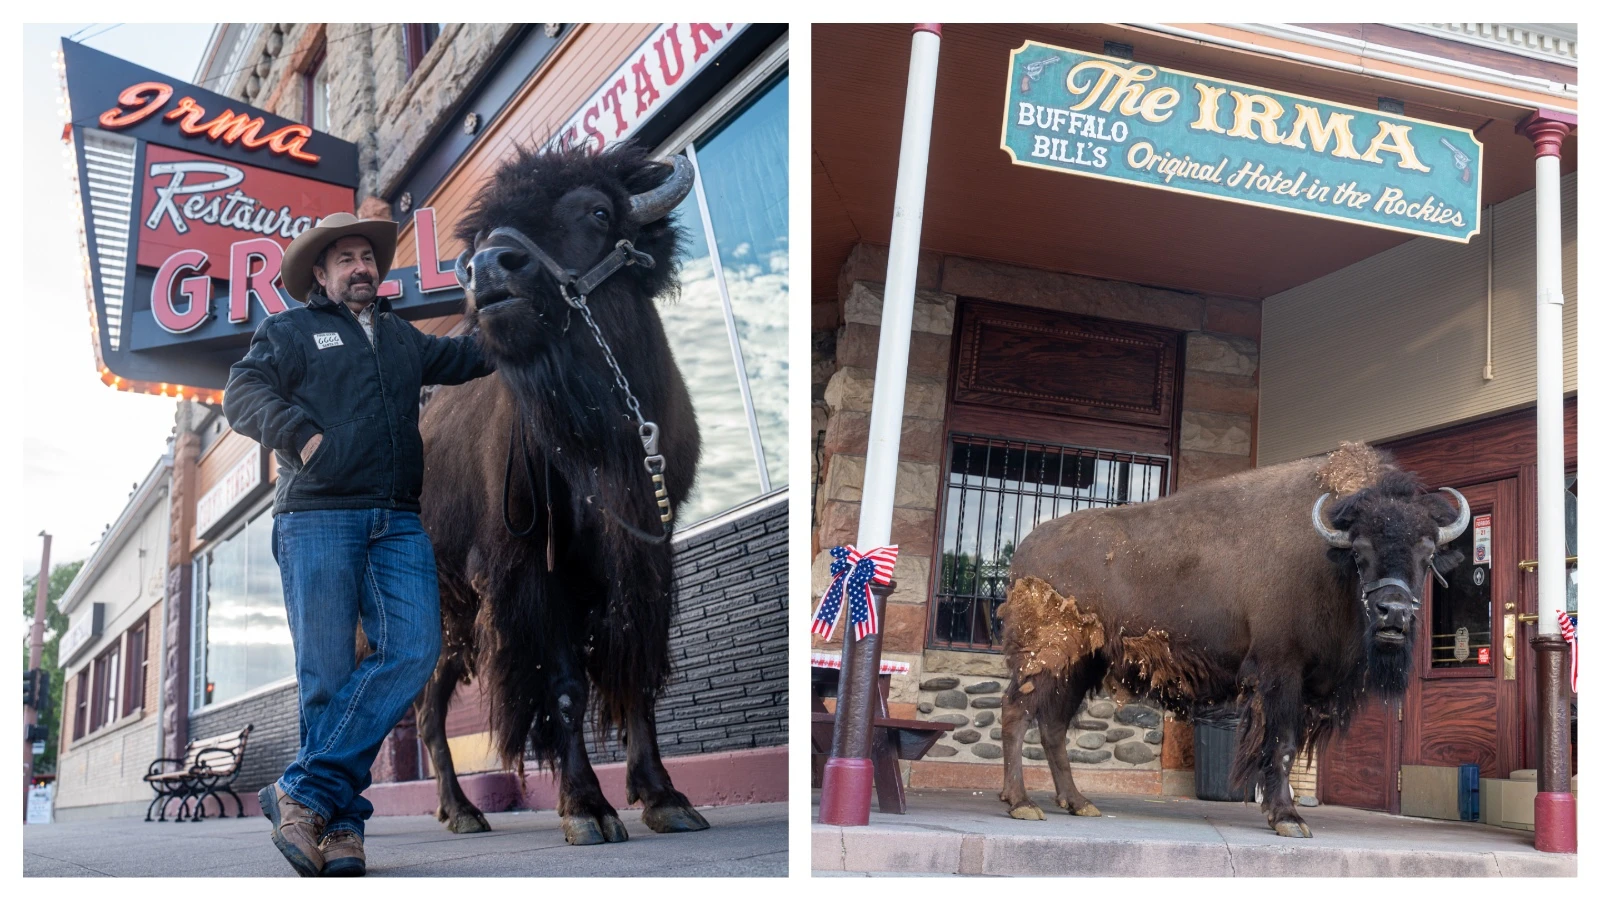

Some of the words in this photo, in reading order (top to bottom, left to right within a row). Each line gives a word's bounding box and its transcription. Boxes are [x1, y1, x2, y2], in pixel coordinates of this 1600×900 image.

[99, 82, 321, 163] Irma
[1018, 102, 1129, 142] BUFFALO
[1031, 135, 1108, 168] BILL'S
[1066, 60, 1181, 122] The
[1190, 83, 1431, 173] IRMA
[145, 162, 322, 240] Restaura
[1127, 142, 1228, 183] Original
[1332, 182, 1372, 209] the
[1374, 187, 1466, 227] Rockies
[151, 207, 464, 333] GRL
